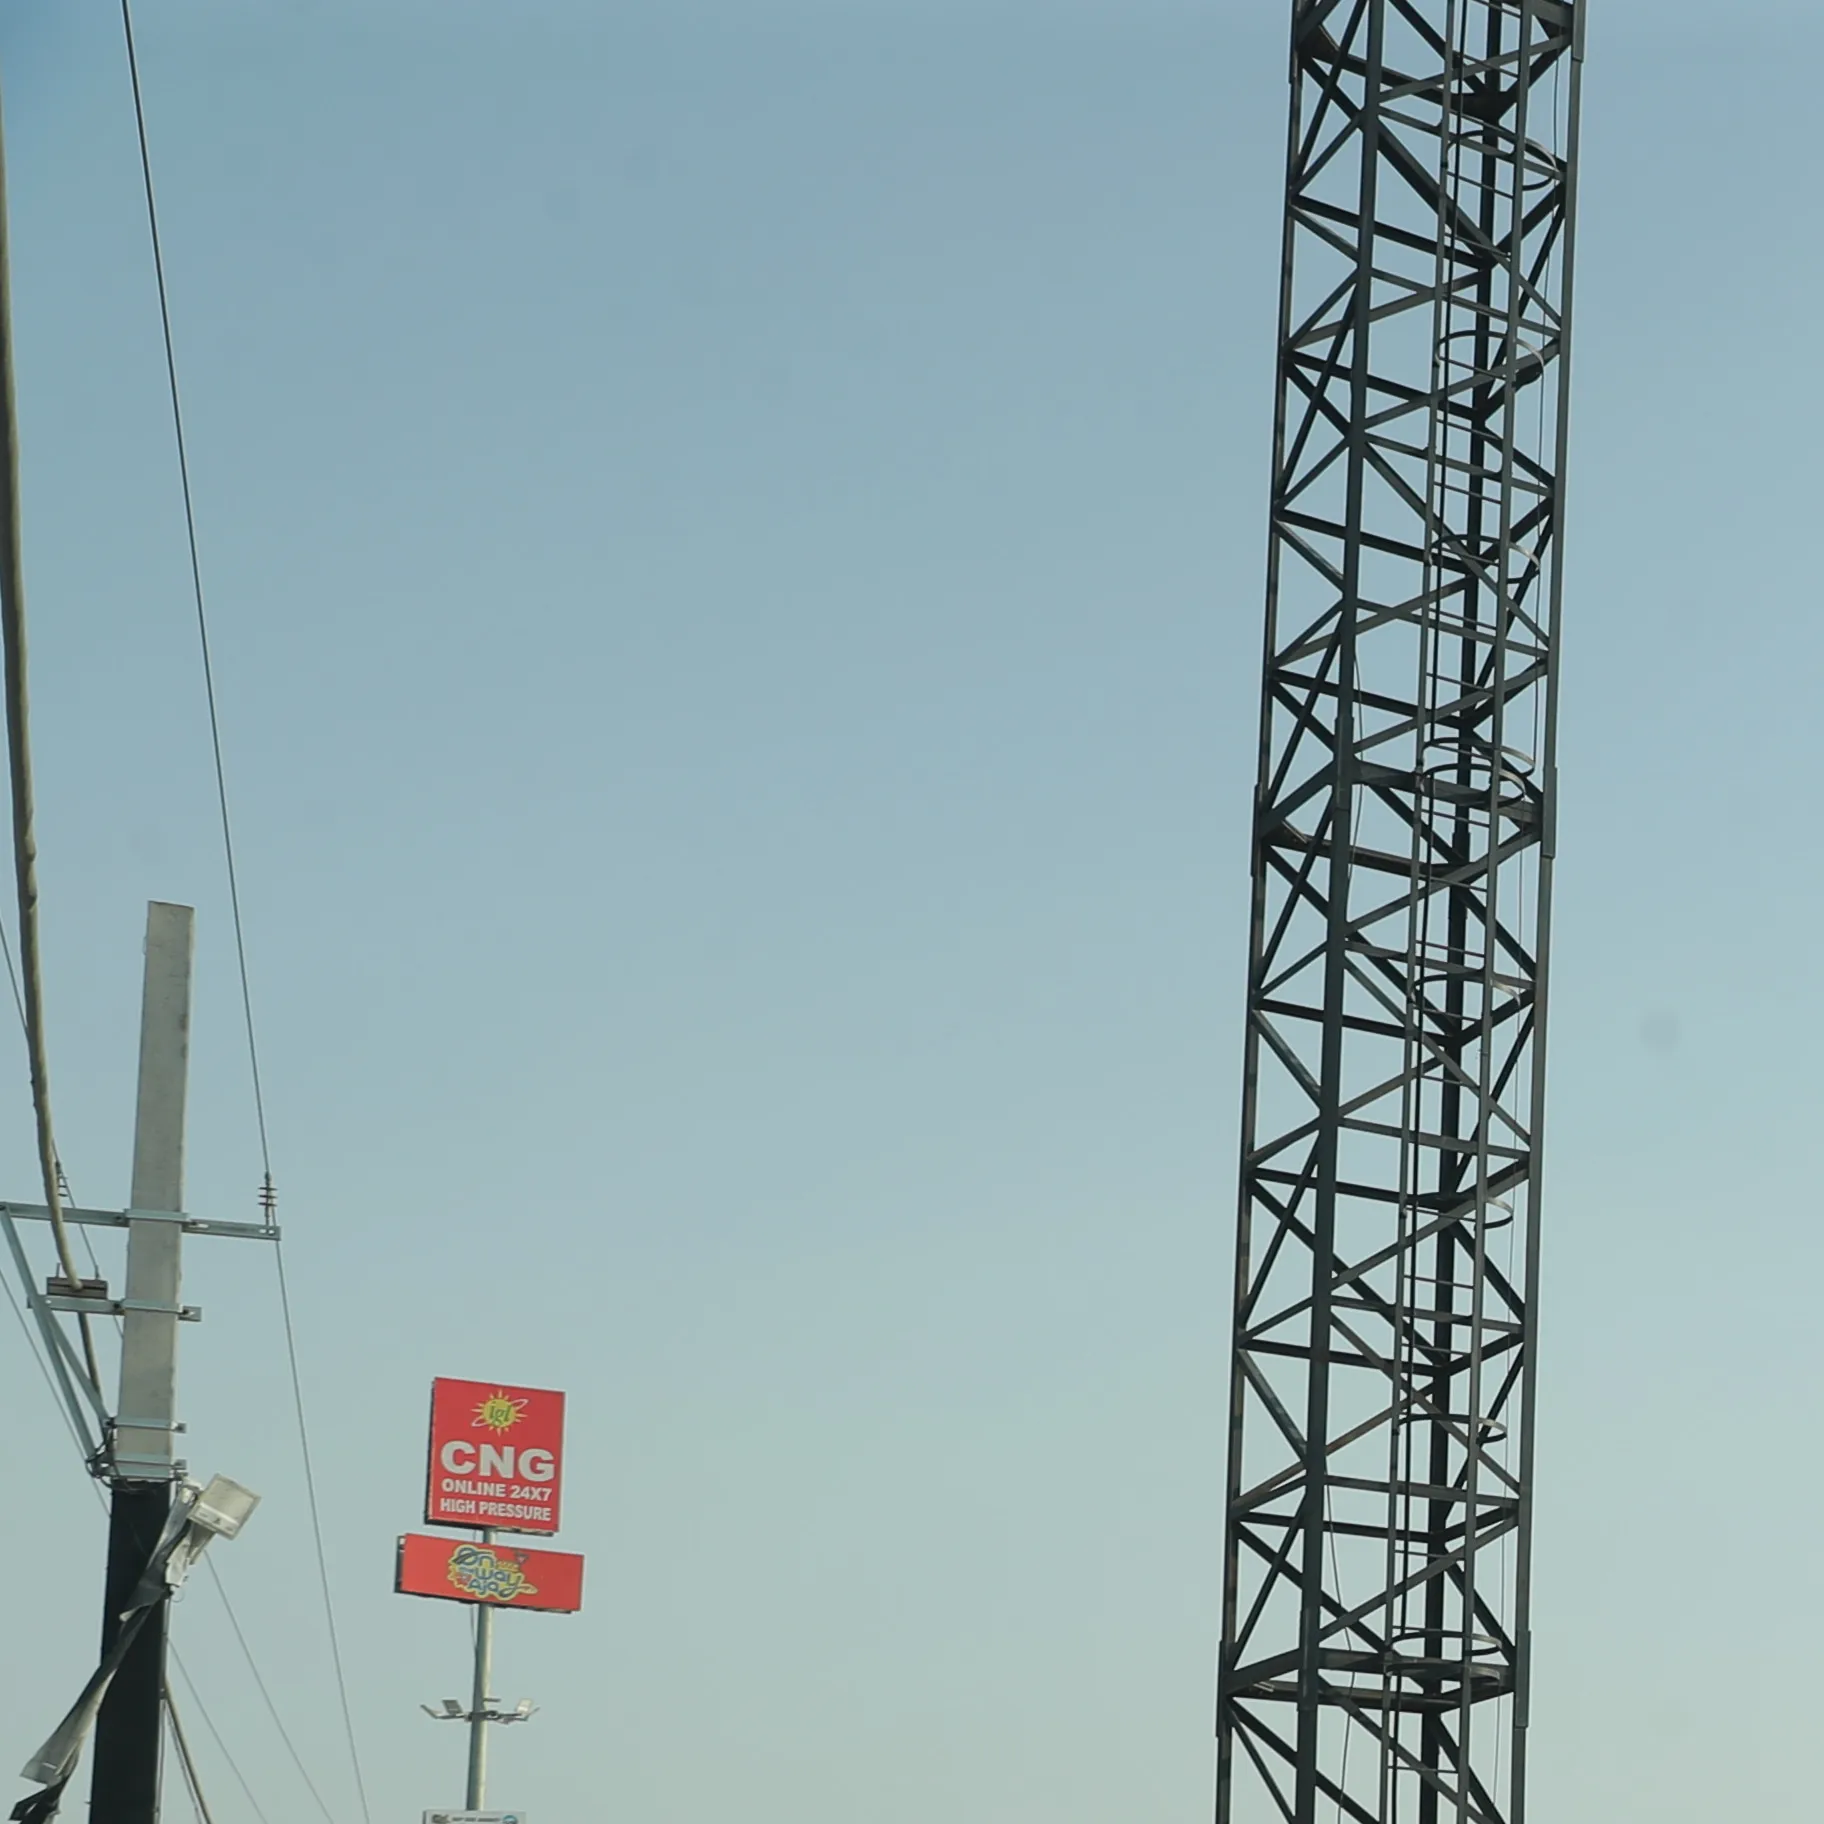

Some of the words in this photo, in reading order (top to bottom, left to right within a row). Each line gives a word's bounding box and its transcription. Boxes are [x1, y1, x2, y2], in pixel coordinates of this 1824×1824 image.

[440, 1440, 556, 1483] CNG
[441, 1478, 507, 1498] ONLINE
[510, 1484, 552, 1502] 24X7
[440, 1498, 477, 1515] HIGH
[479, 1501, 552, 1522] PRESSURE
